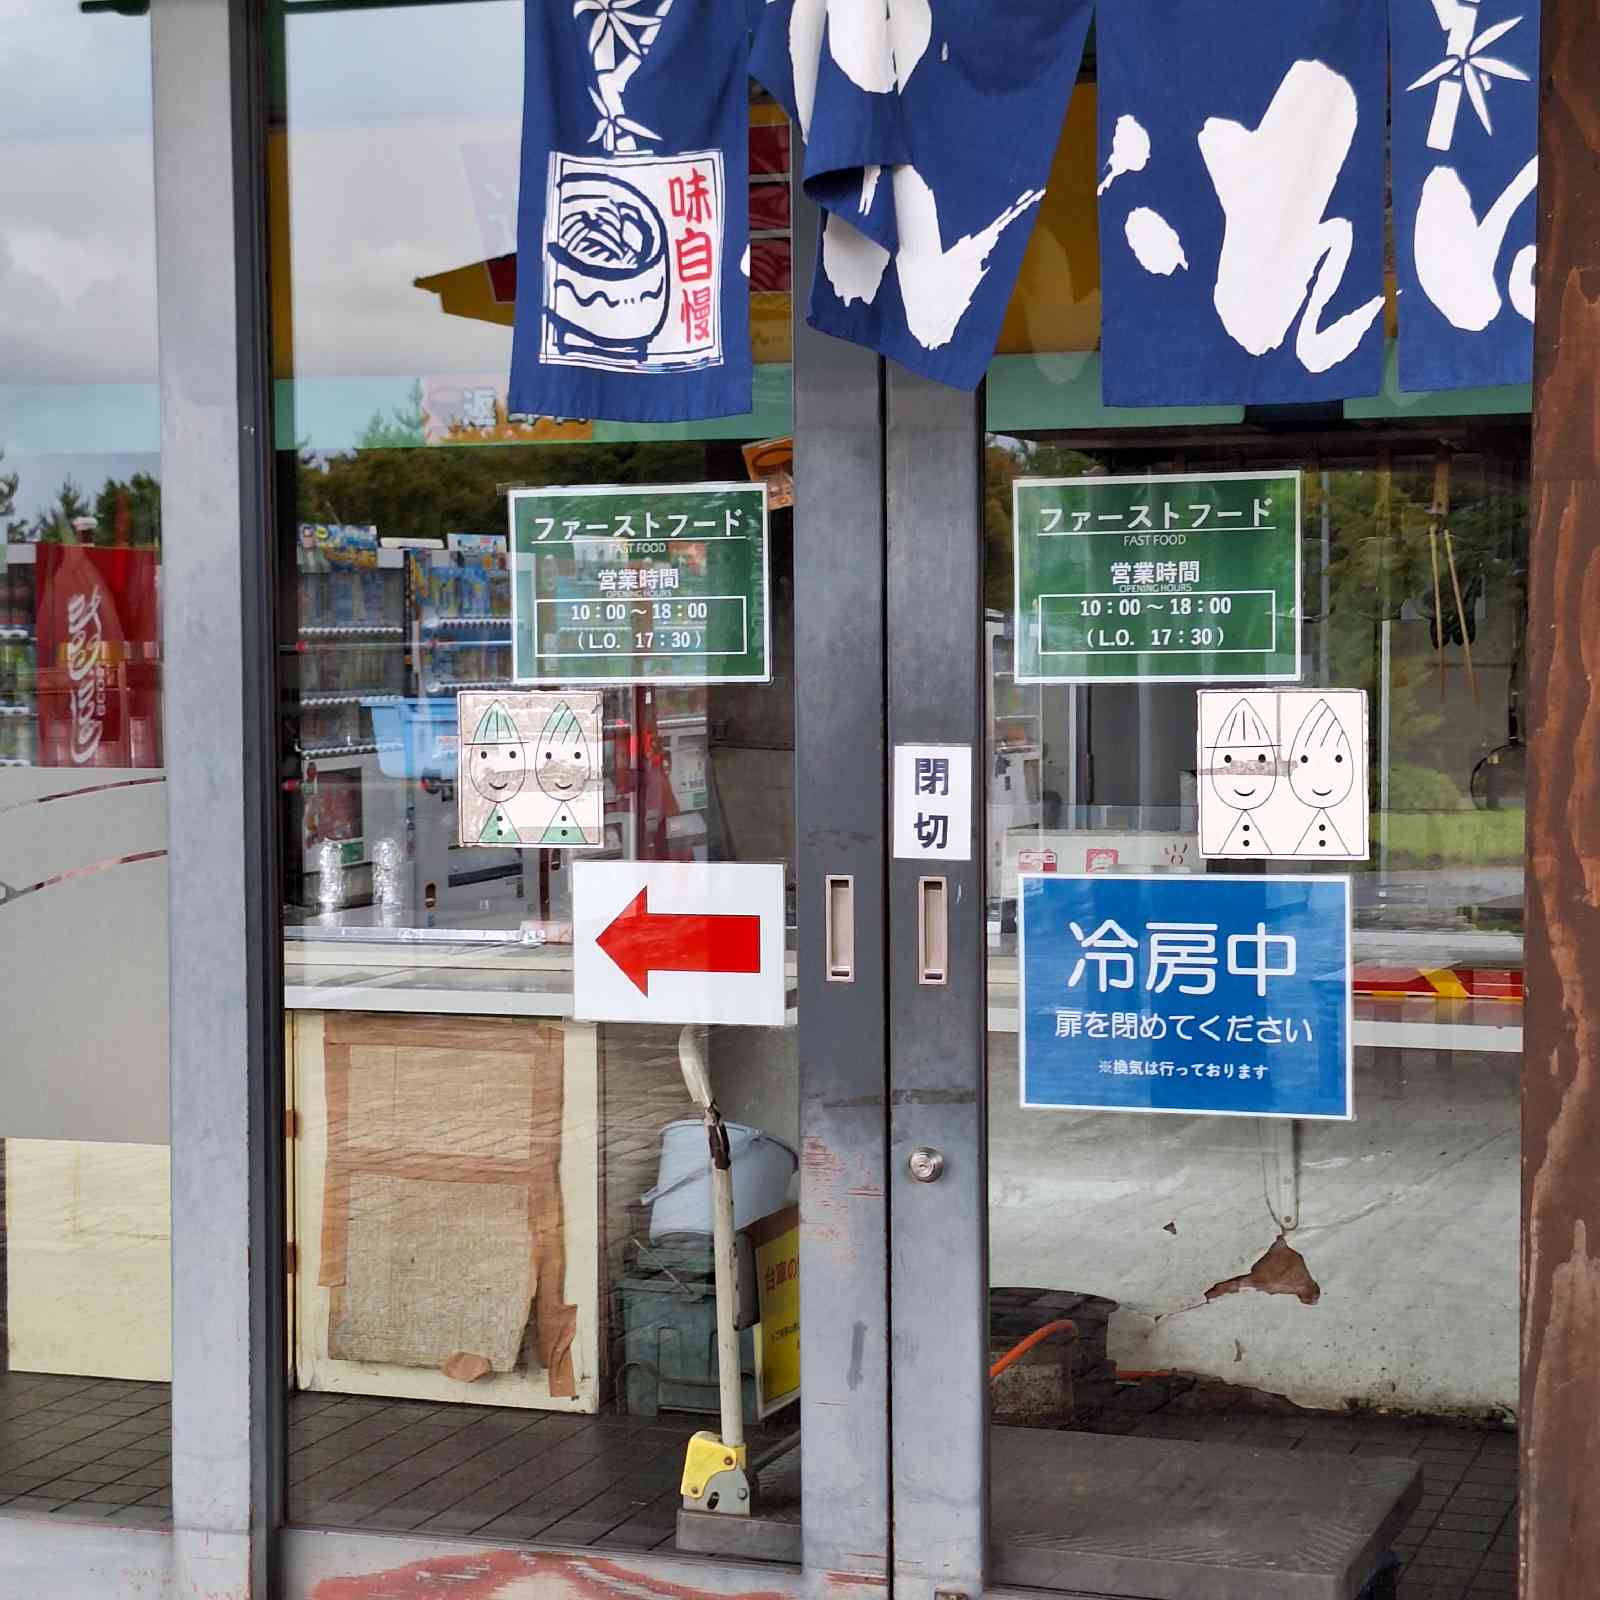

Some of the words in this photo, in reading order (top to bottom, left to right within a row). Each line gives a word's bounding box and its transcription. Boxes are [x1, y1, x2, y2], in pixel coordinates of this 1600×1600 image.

[668, 167, 713, 344] 味自慢
[535, 509, 742, 540] ファーストフード
[1040, 497, 1272, 532] ファーストフード
[637, 542, 666, 553] FOOD
[1123, 535, 1151, 546] FAST
[1153, 534, 1186, 545] FOOD
[598, 568, 679, 591] 営業時間
[1111, 560, 1200, 585] 営業時間
[1120, 583, 1159, 593] OPENING
[1161, 583, 1193, 593] HOURS
[913, 757, 951, 850] 閉切
[1067, 919, 1297, 997] 冷房中
[1055, 1010, 1314, 1044] 扉を閉めてください
